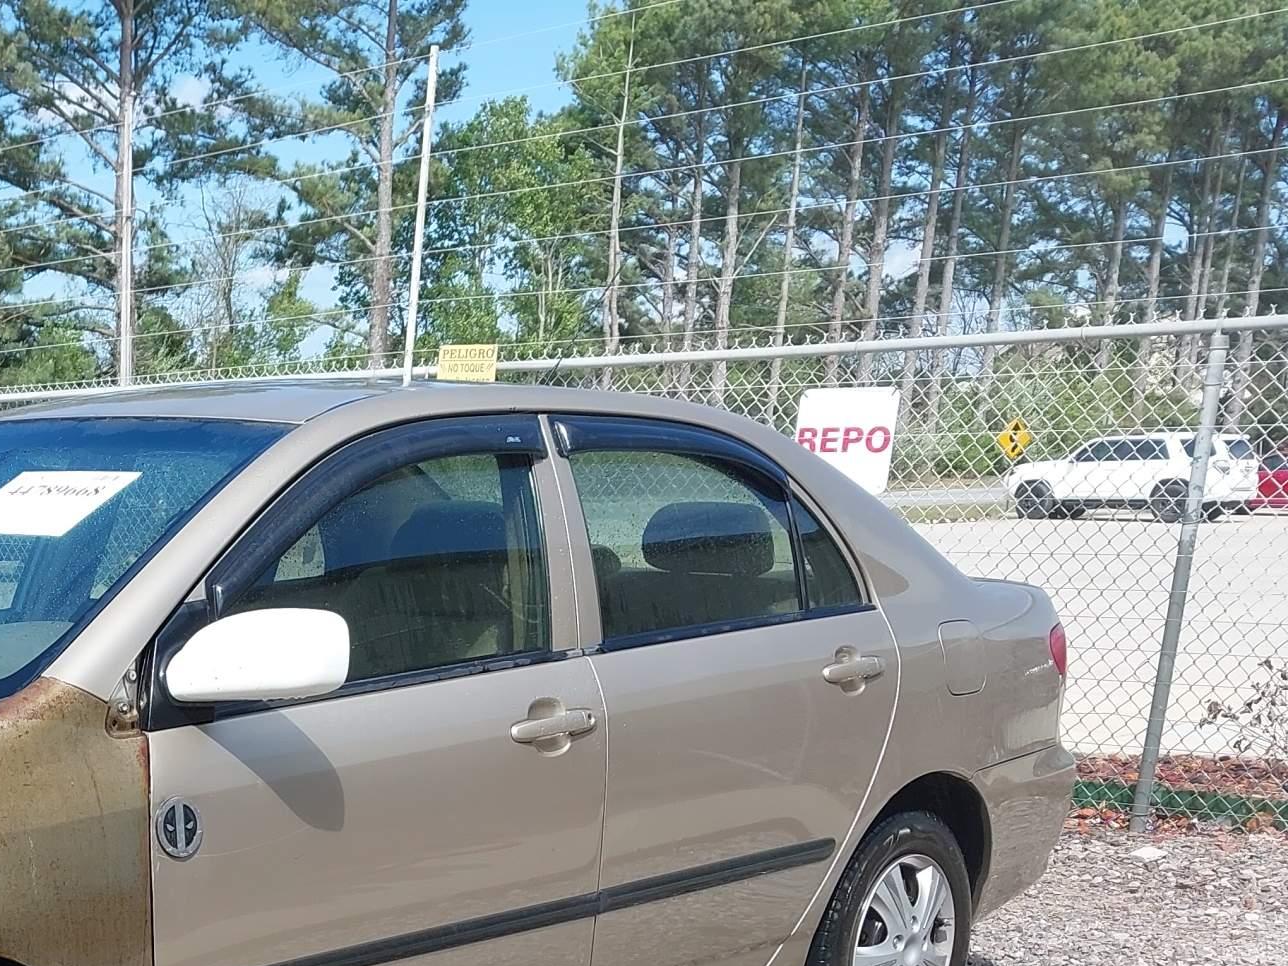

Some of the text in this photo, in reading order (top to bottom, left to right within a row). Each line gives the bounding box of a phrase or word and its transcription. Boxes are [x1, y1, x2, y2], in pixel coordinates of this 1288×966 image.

[442, 348, 495, 359] PELIGRO
[448, 363, 485, 373] NO TOQUE
[797, 426, 891, 453] REPO
